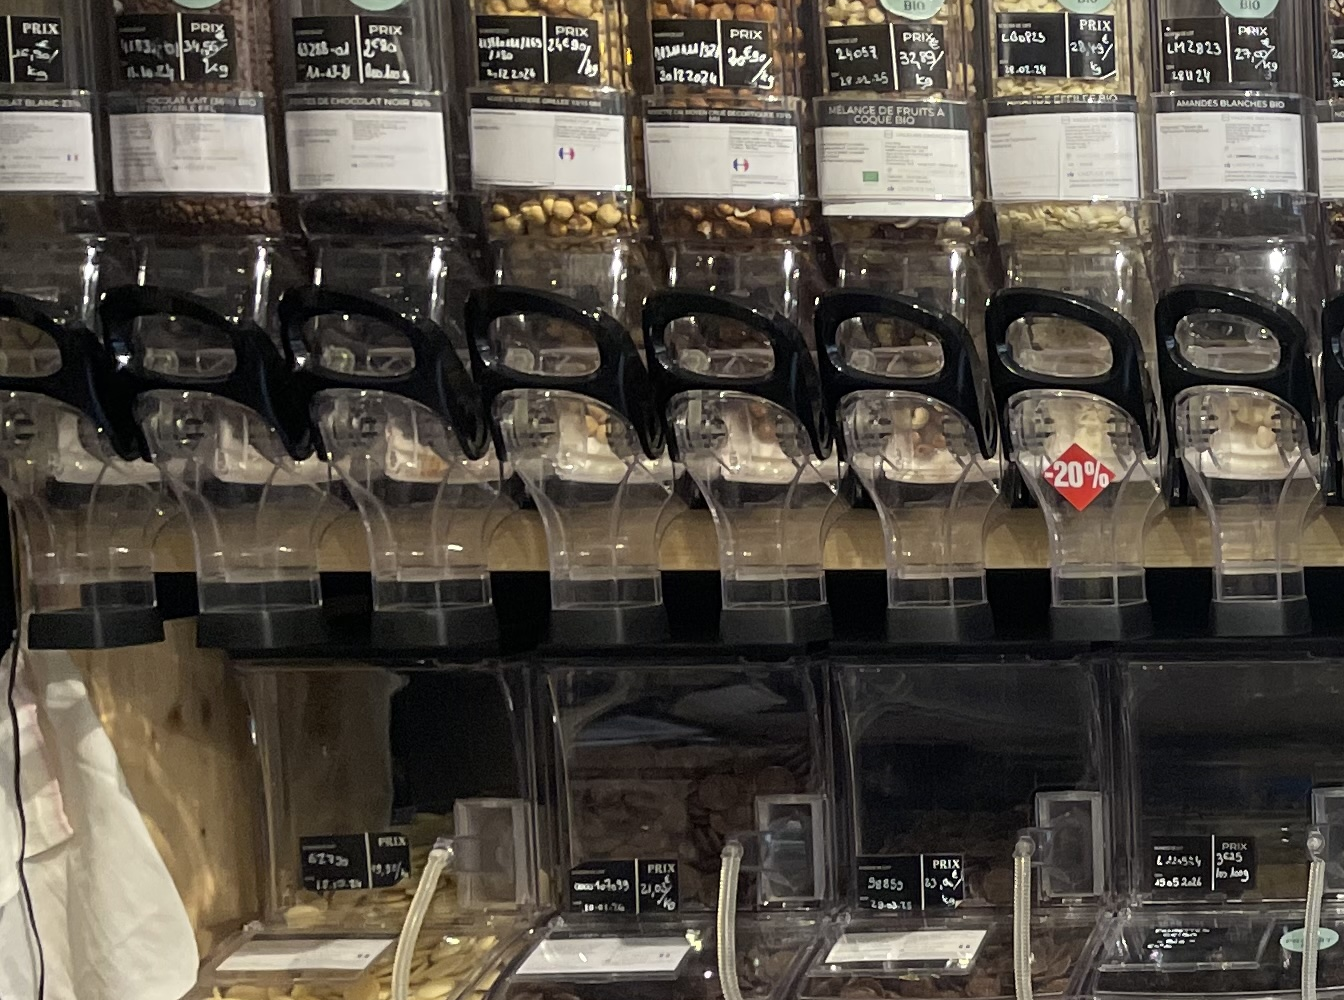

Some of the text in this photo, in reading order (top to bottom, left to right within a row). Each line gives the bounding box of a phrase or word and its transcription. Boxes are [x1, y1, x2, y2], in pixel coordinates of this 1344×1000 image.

[22, 23, 59, 35] PRIX
[190, 23, 224, 33] PRIX
[368, 25, 402, 35] PRIX
[1079, 20, 1112, 31] PRIX
[1237, 26, 1268, 36] PRIX
[555, 26, 588, 37] PRIX
[730, 29, 763, 40] PRIX
[902, 33, 935, 44] PRIX
[1090, 62, 1102, 75] kg
[916, 74, 933, 89] kg
[330, 98, 381, 106] CHOCOLAT
[1176, 99, 1285, 109] AMANDES BLANCHES BIO
[878, 107, 894, 116] DE
[896, 107, 935, 117] FRUITS
[853, 115, 916, 126] COQUE BIO
[1043, 460, 1109, 489] -20%
[1222, 843, 1248, 851] PRIX
[648, 864, 675, 874] PRIX
[933, 859, 960, 870] PRIX
